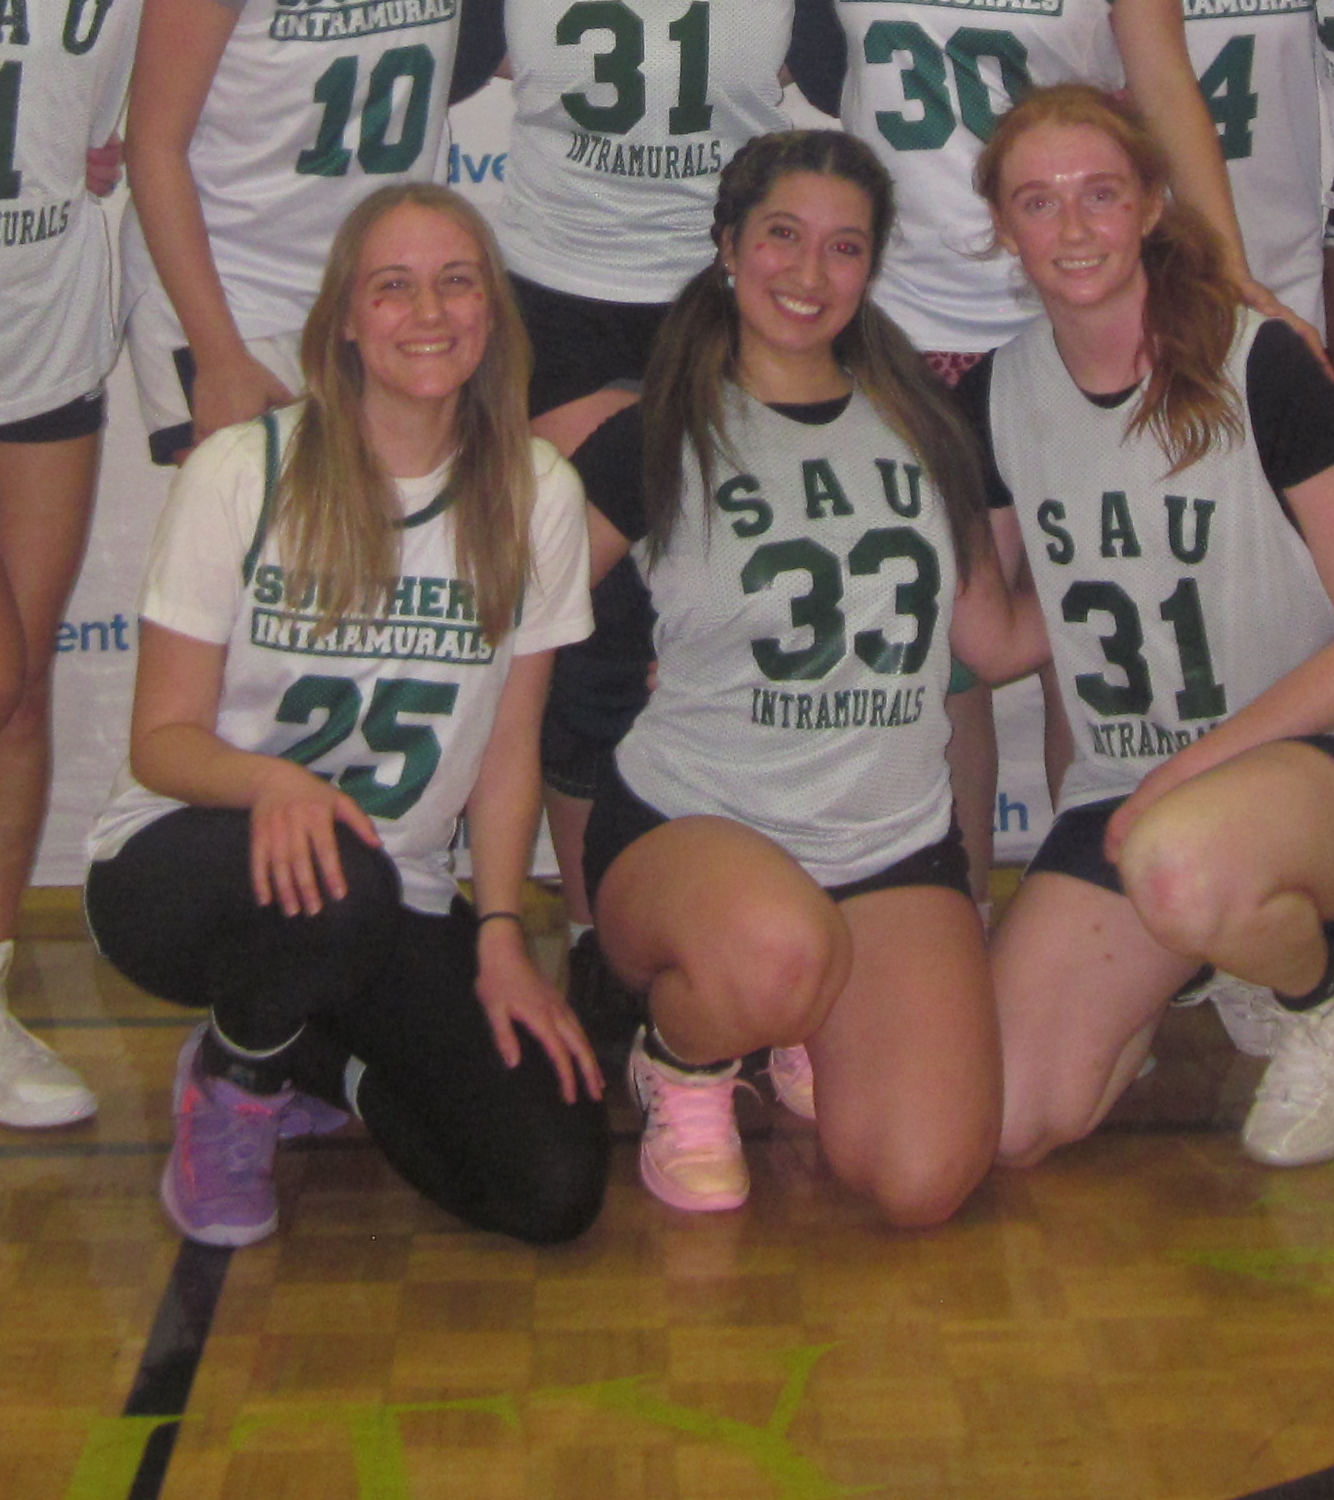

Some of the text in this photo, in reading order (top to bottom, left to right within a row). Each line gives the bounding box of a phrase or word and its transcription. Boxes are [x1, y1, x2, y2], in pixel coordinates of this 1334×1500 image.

[296, 43, 435, 177] 10
[555, 0, 714, 136] 31
[863, 20, 1033, 151] 30
[567, 132, 722, 179] INTRAMURALS
[740, 526, 941, 681] 33
[1060, 577, 1228, 721] 31
[274, 675, 460, 820] 25
[751, 685, 925, 729] INTRAMURALS
